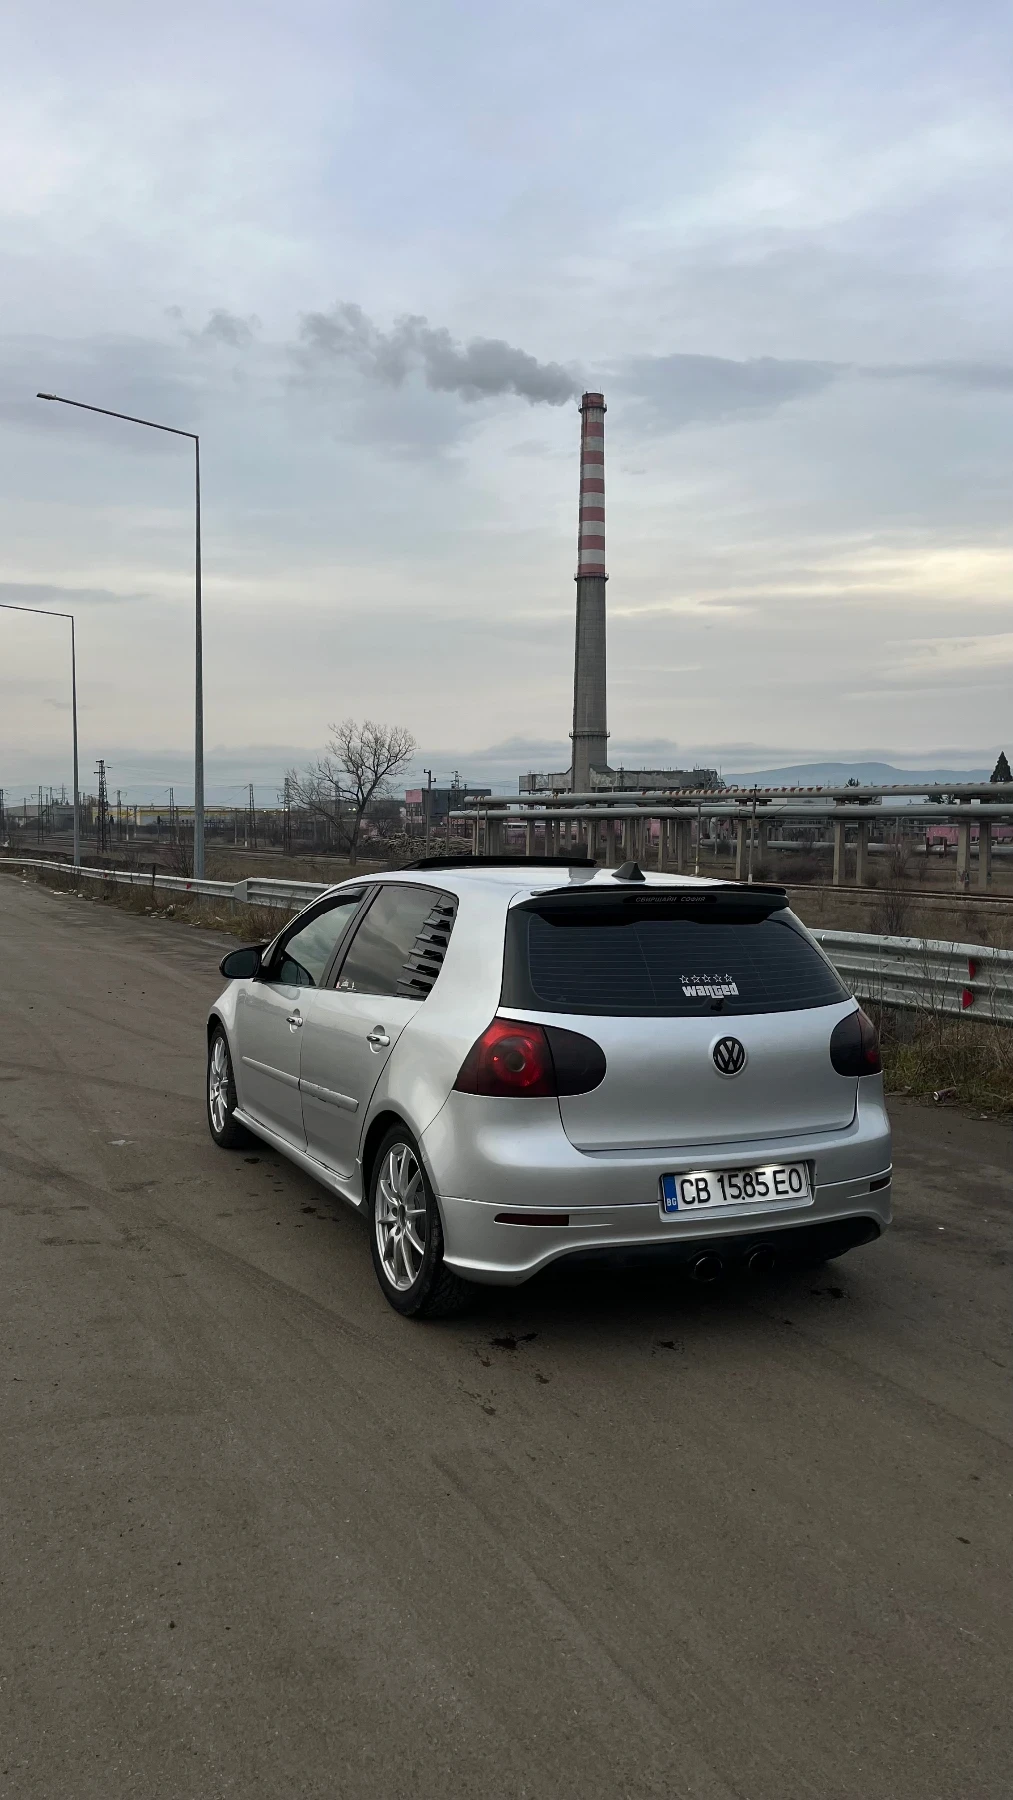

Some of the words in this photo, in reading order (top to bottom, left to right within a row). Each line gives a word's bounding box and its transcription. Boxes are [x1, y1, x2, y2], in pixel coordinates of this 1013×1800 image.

[713, 1036, 745, 1075] VW
[666, 1197, 677, 1207] BG
[680, 1177, 711, 1205] CB
